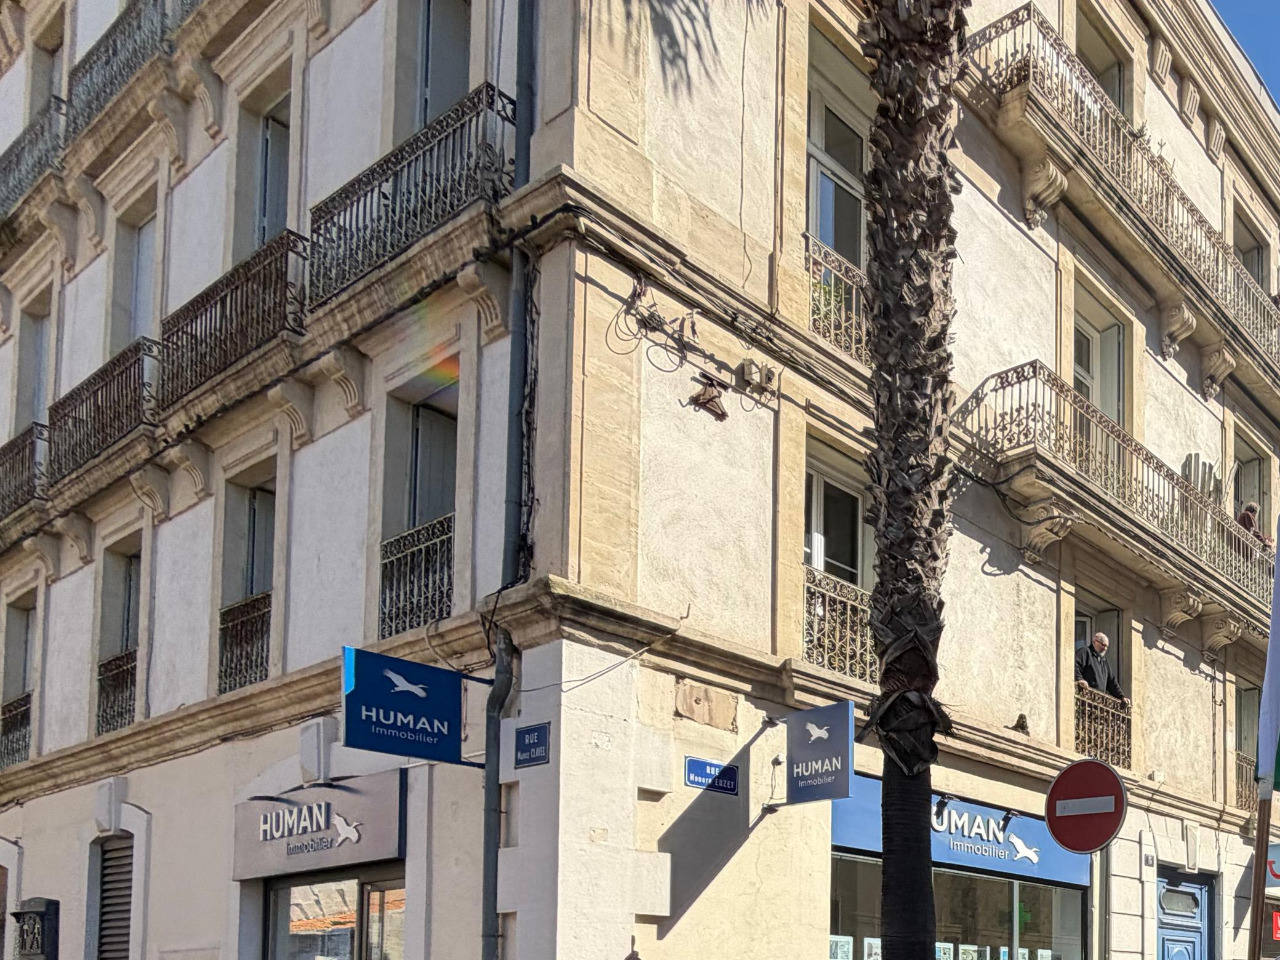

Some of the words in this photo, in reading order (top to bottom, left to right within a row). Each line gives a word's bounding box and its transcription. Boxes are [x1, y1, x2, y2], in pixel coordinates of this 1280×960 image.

[361, 705, 449, 735] HUMAN
[371, 724, 439, 744] Immobilier
[525, 732, 538, 745] RUE
[706, 765, 720, 776] RUE
[793, 756, 842, 778] HUMAN
[798, 775, 835, 788] Immobilier
[259, 801, 329, 842] HUMAN
[930, 805, 1004, 845] UMAN
[949, 837, 1010, 860] Immobilier
